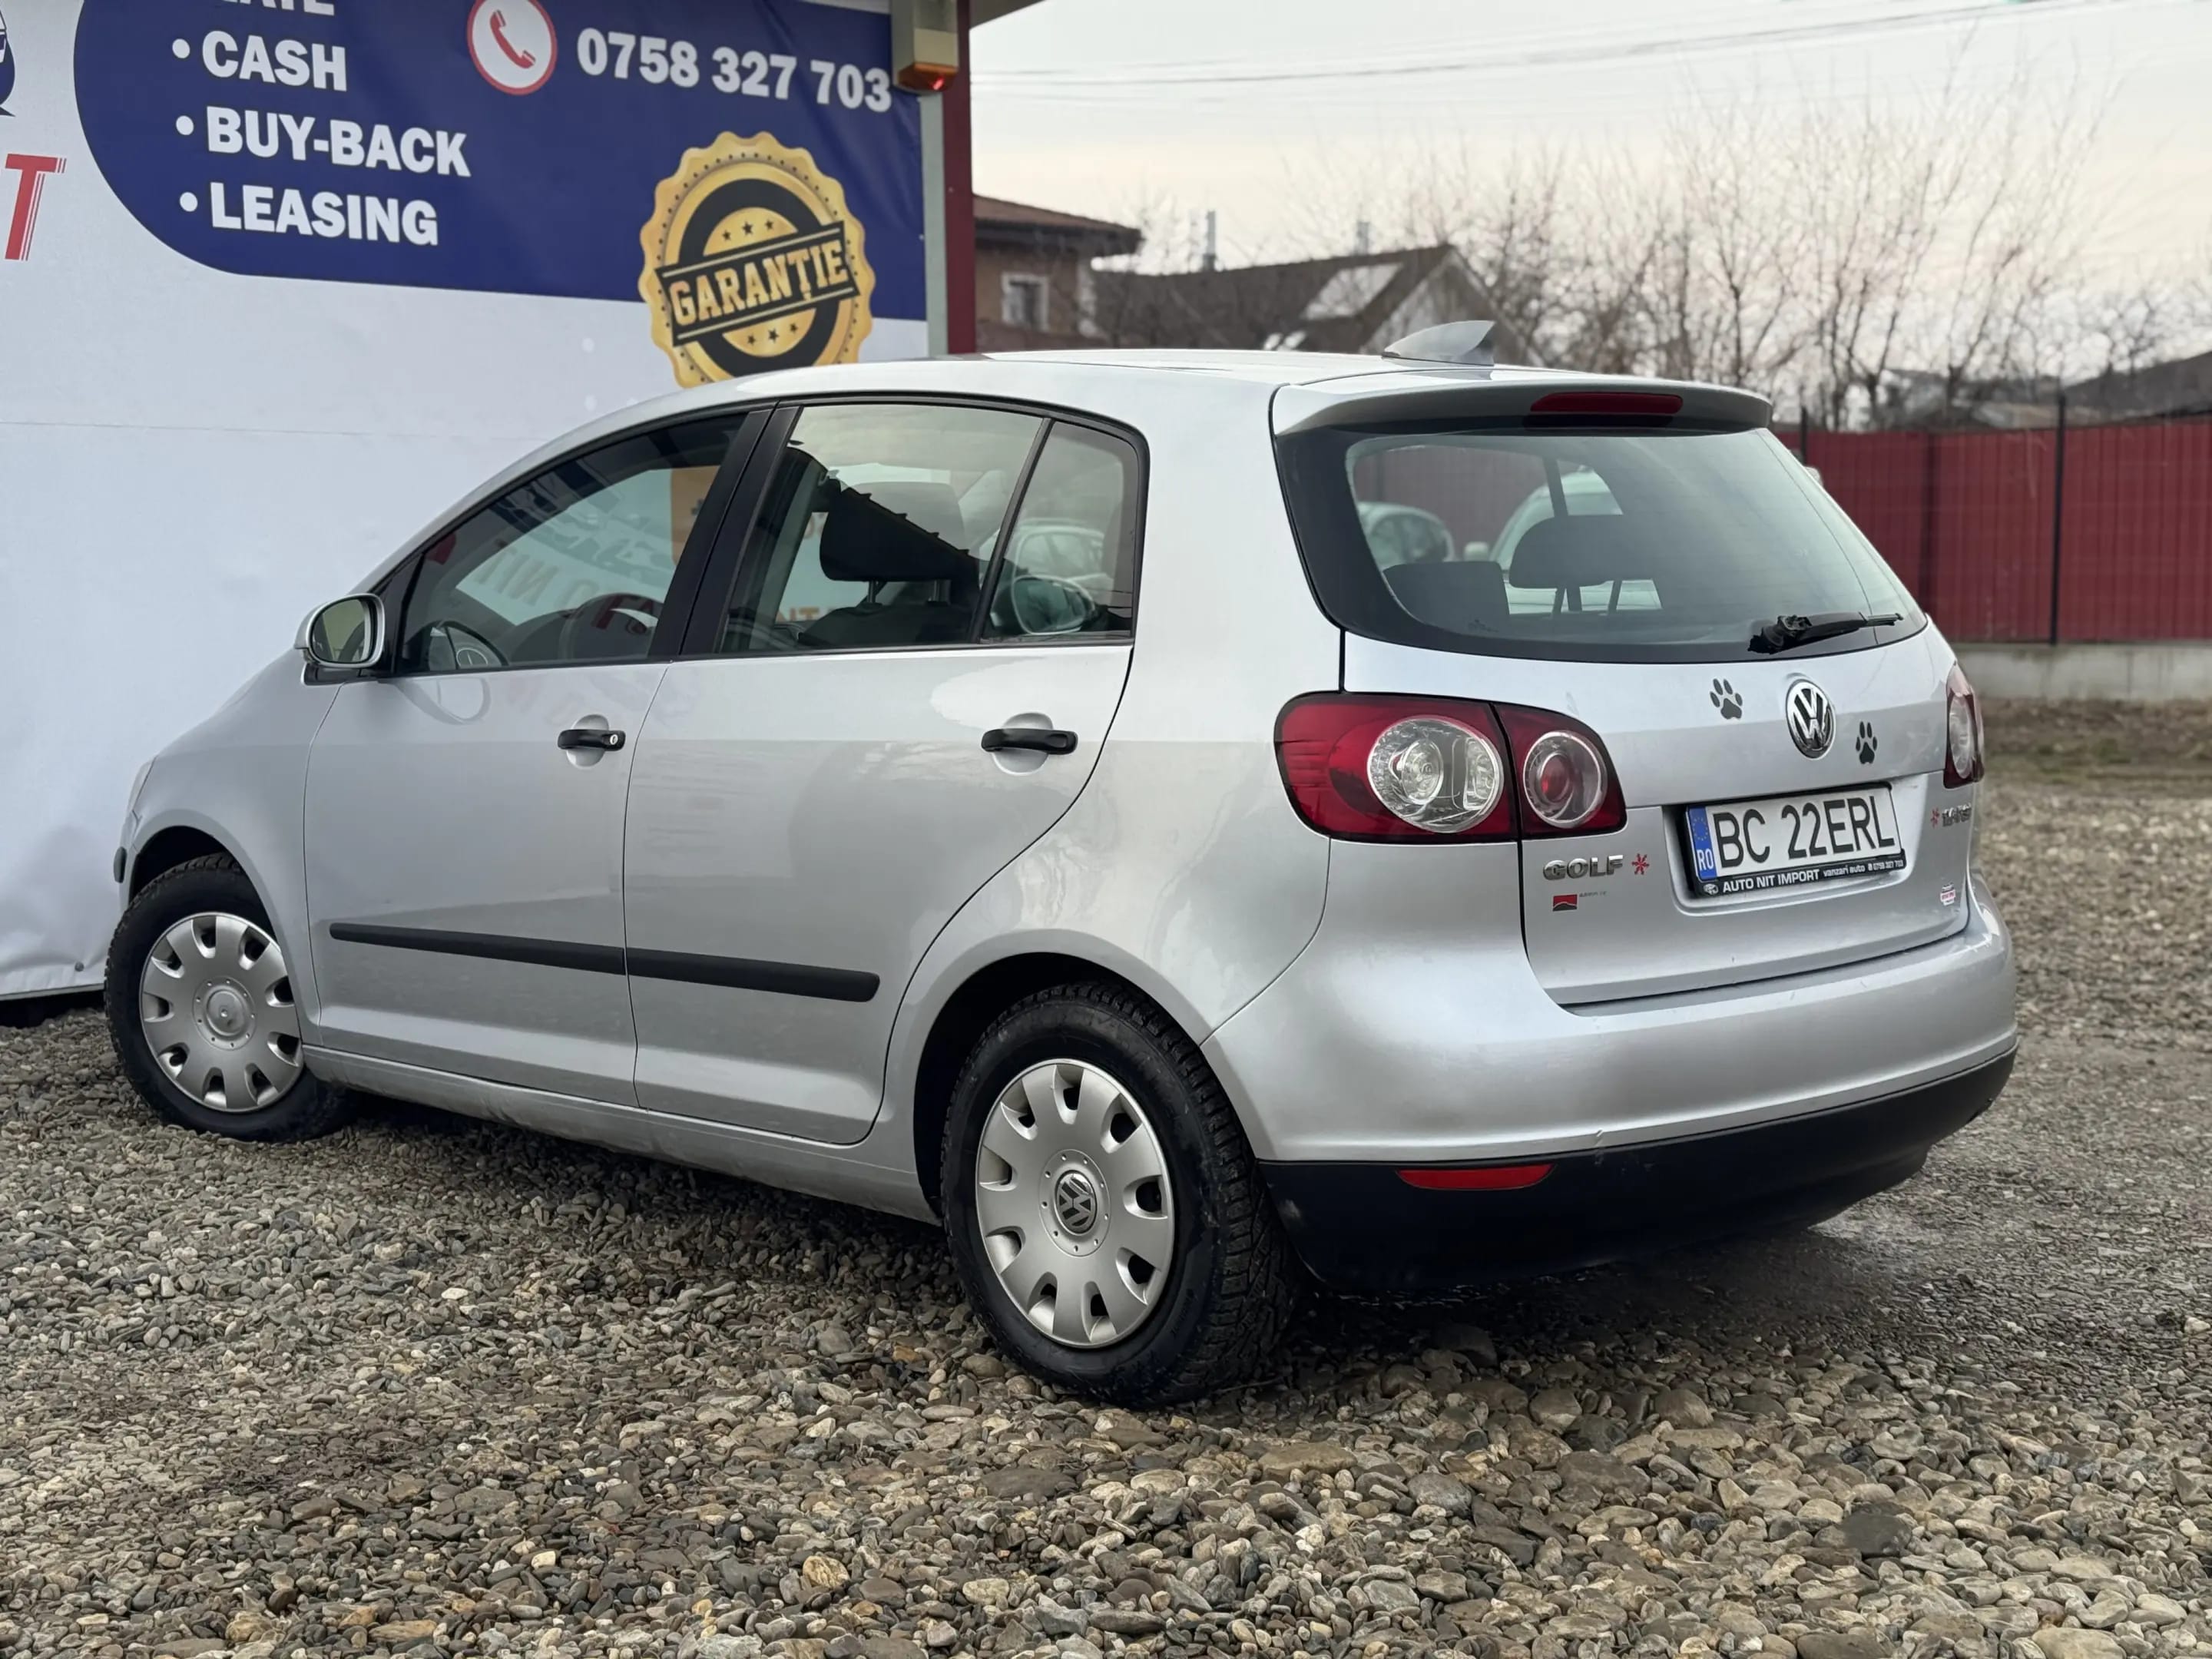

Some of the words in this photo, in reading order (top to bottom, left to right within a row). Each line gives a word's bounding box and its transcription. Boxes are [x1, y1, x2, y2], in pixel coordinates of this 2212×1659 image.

[202, 30, 348, 91] CASH
[576, 28, 700, 88] 0758
[711, 47, 797, 100] 327
[810, 61, 892, 113] 703
[206, 105, 472, 177] BUY-BACK
[210, 181, 439, 246] LEASING
[1698, 847, 1714, 871] RO
[1712, 808, 1770, 869] BC
[1781, 795, 1896, 860] 22ERL
[1542, 854, 1624, 881] GOLF
[1722, 879, 1754, 893] AUTO
[1757, 876, 1775, 888] NIT
[1777, 869, 1820, 885] IMPORT
[1849, 865, 1866, 874] auto
